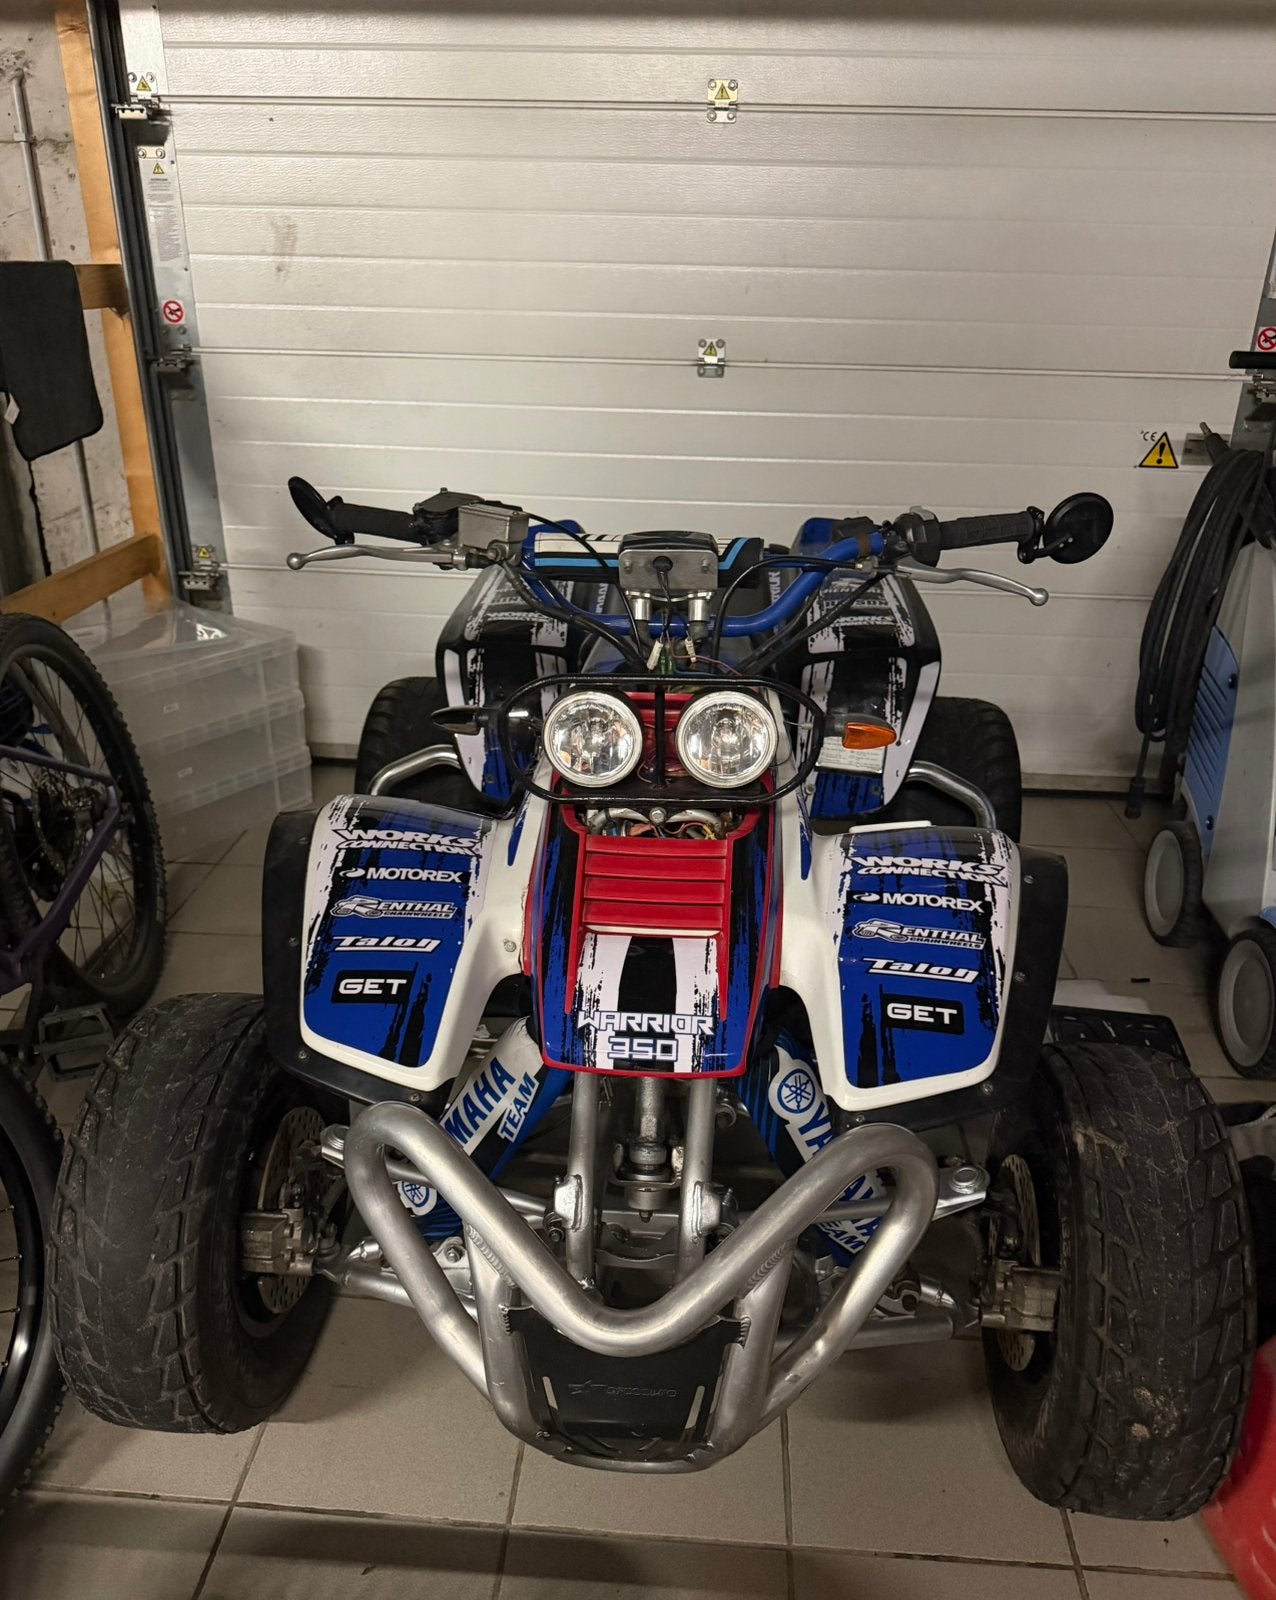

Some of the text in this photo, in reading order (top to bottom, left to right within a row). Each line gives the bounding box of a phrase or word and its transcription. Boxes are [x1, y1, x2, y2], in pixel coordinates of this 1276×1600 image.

[337, 840, 478, 856] CONNECTION
[338, 829, 480, 848] WORKS
[366, 868, 462, 883] MOTOREX
[851, 856, 1006, 876] WORKS
[857, 866, 1007, 887] CONNECTION
[331, 895, 456, 918] RENTHAL
[883, 892, 984, 913] MOTOREX
[852, 918, 985, 945] RENTHAL
[333, 936, 441, 952] Talon
[863, 957, 979, 983] Talon
[338, 978, 407, 995] GET
[578, 1011, 714, 1035] WARRIOR
[886, 1002, 957, 1025] GET
[607, 1037, 678, 1062] 350
[444, 1057, 516, 1145] MAHA
[500, 1071, 536, 1139] TEAM
[818, 1220, 866, 1251] EAM
